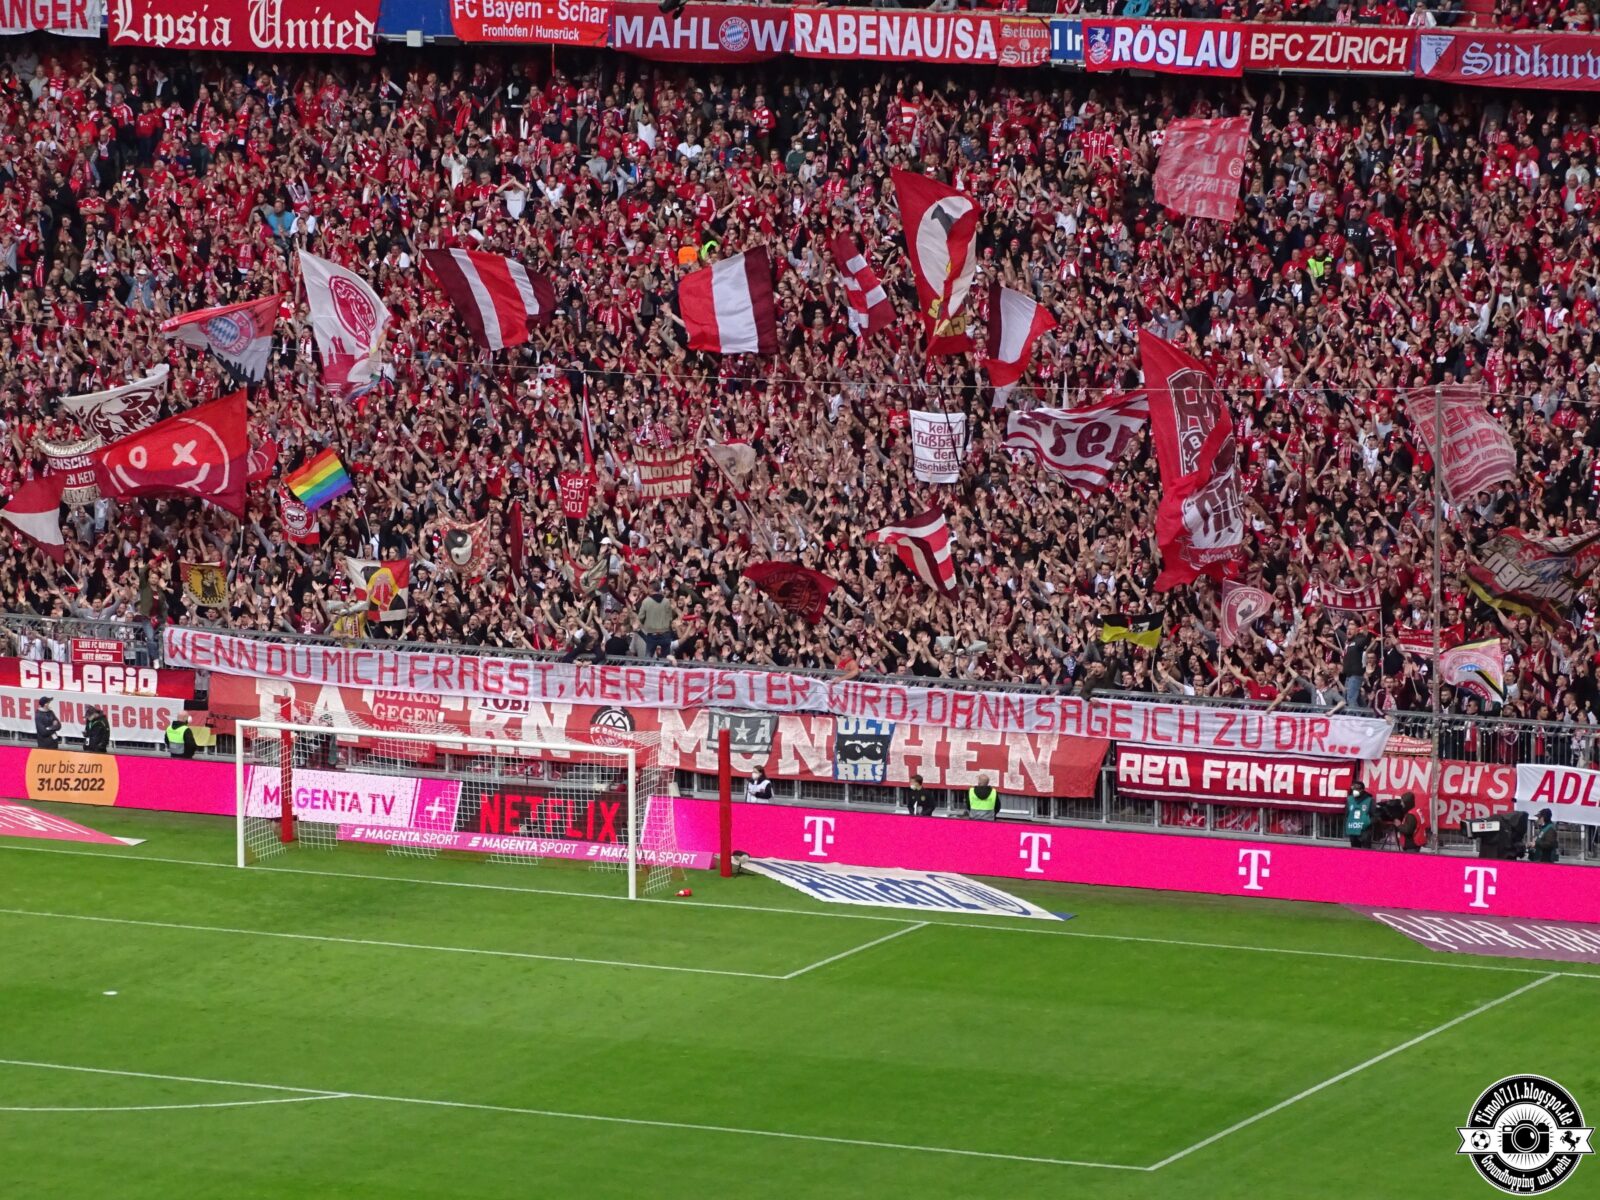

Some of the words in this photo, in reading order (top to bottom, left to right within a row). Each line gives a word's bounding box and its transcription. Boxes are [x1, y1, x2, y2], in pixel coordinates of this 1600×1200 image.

[112, 0, 232, 47] Lipsia
[249, 0, 375, 50] United
[455, 0, 477, 18] FC
[483, 0, 542, 19] Bayern
[482, 24, 528, 38] Fronhofen
[535, 27, 579, 41] Hunsrück
[793, 13, 997, 60] RABENAU/SA
[1111, 24, 1241, 69] RÖSLAU
[1250, 33, 1302, 61] BFC
[1306, 31, 1408, 65] ZÜRICH
[640, 460, 692, 480] MODUS
[914, 458, 958, 473] faschiste
[167, 629, 257, 671] WENN
[267, 644, 312, 679] DU
[322, 651, 399, 686] MICH
[408, 654, 566, 699] FRAGST,
[574, 665, 646, 701] WER
[658, 671, 809, 706] MEISTER
[826, 682, 918, 723] WIRD,
[926, 690, 1024, 730] DANN
[1035, 696, 1133, 739] SAGE
[1141, 707, 1200, 744] ICH
[1213, 712, 1264, 749] ZU
[1275, 715, 1361, 754] DIR...
[372, 703, 440, 725] GEGEN
[657, 704, 1059, 794] MNHEN
[37, 763, 57, 774] nur
[58, 760, 75, 774] bis
[77, 763, 102, 774] zum
[37, 777, 105, 792] 31.05.2022
[263, 784, 363, 813] MGENTA
[368, 793, 396, 816] TV
[479, 793, 620, 842] NETFLIX
[1348, 822, 1364, 830] HOST
[365, 828, 420, 843] MAGENTA
[422, 832, 460, 845] SPORT
[481, 836, 538, 853] MAGENTA
[540, 841, 578, 856] SPORT
[804, 815, 835, 857] T
[1019, 831, 1051, 874] T
[600, 846, 656, 862] MAGNTA
[658, 852, 698, 865] SPORT
[1238, 848, 1271, 890] T
[1464, 866, 1497, 908] T
[1372, 912, 1542, 950] QATAR
